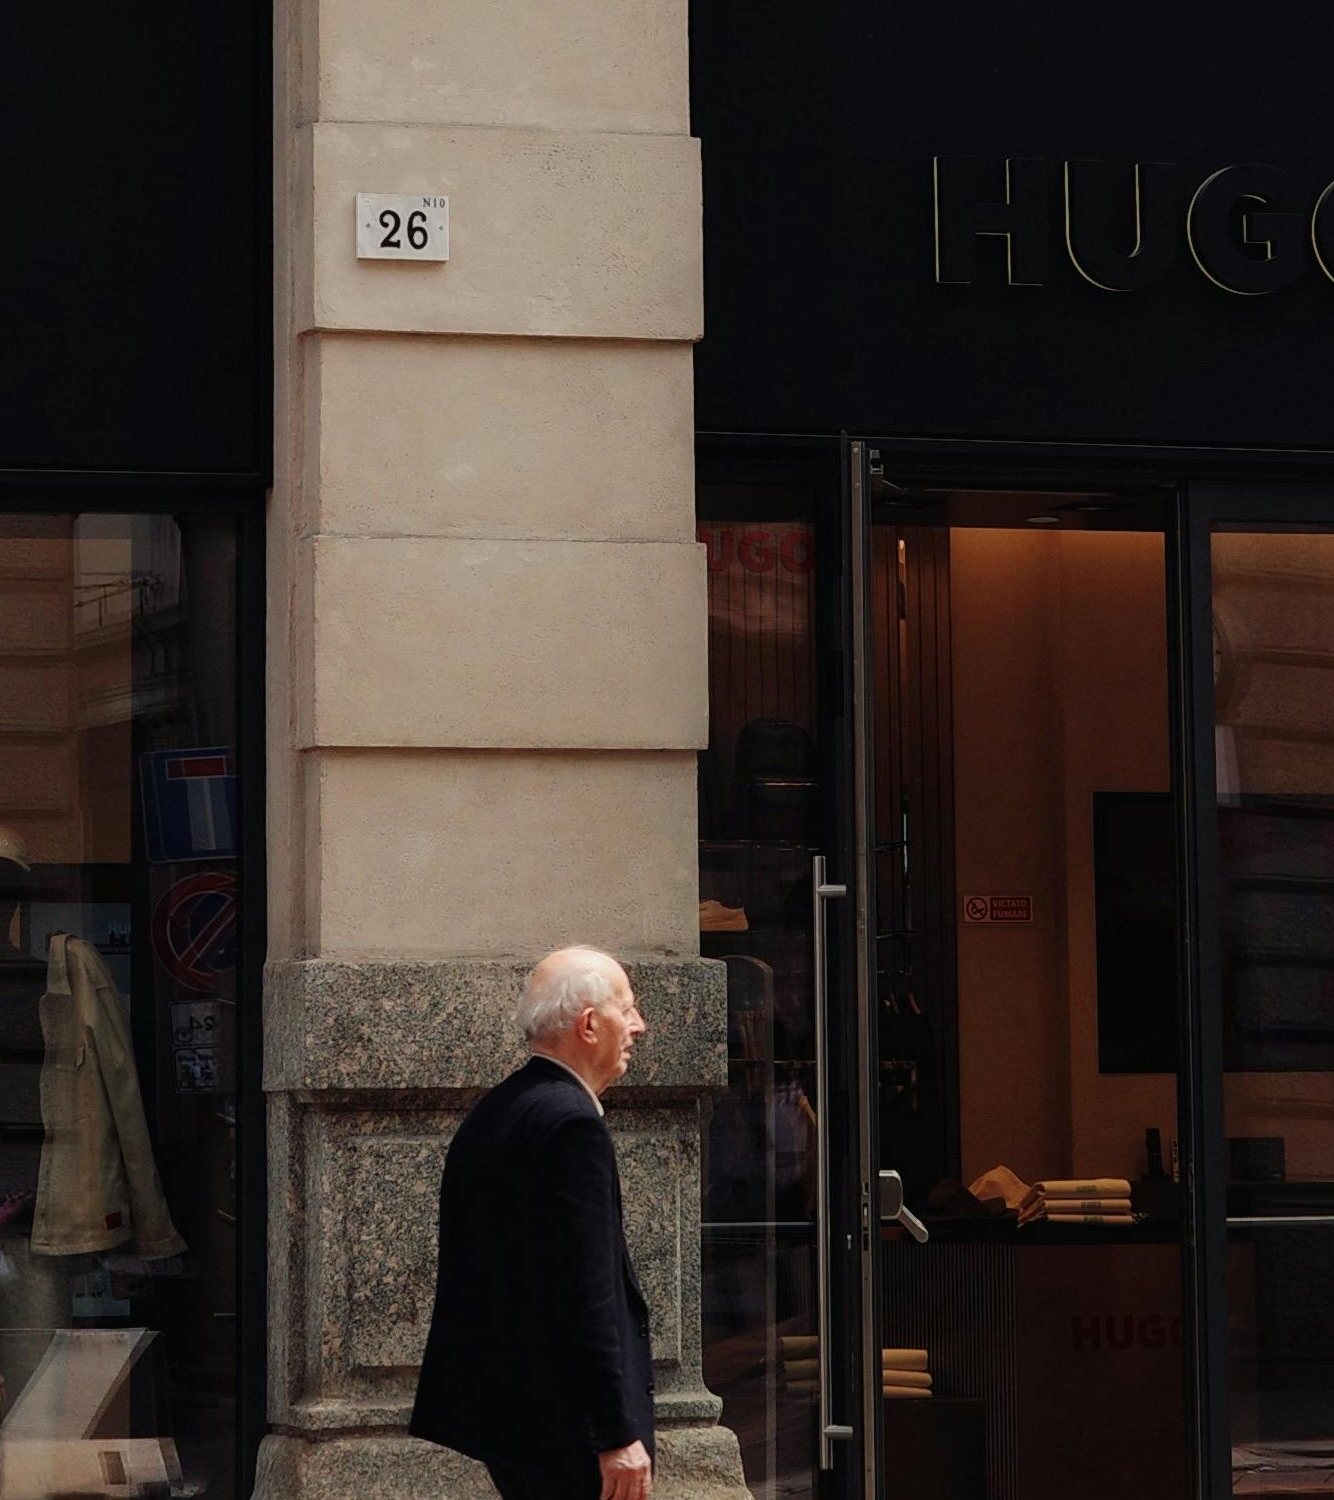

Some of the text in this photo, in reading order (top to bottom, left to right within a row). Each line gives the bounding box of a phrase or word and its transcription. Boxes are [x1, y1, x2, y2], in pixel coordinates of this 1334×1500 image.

[422, 197, 446, 208] N10
[378, 209, 428, 250] 26
[992, 899, 1027, 907] VIETATO
